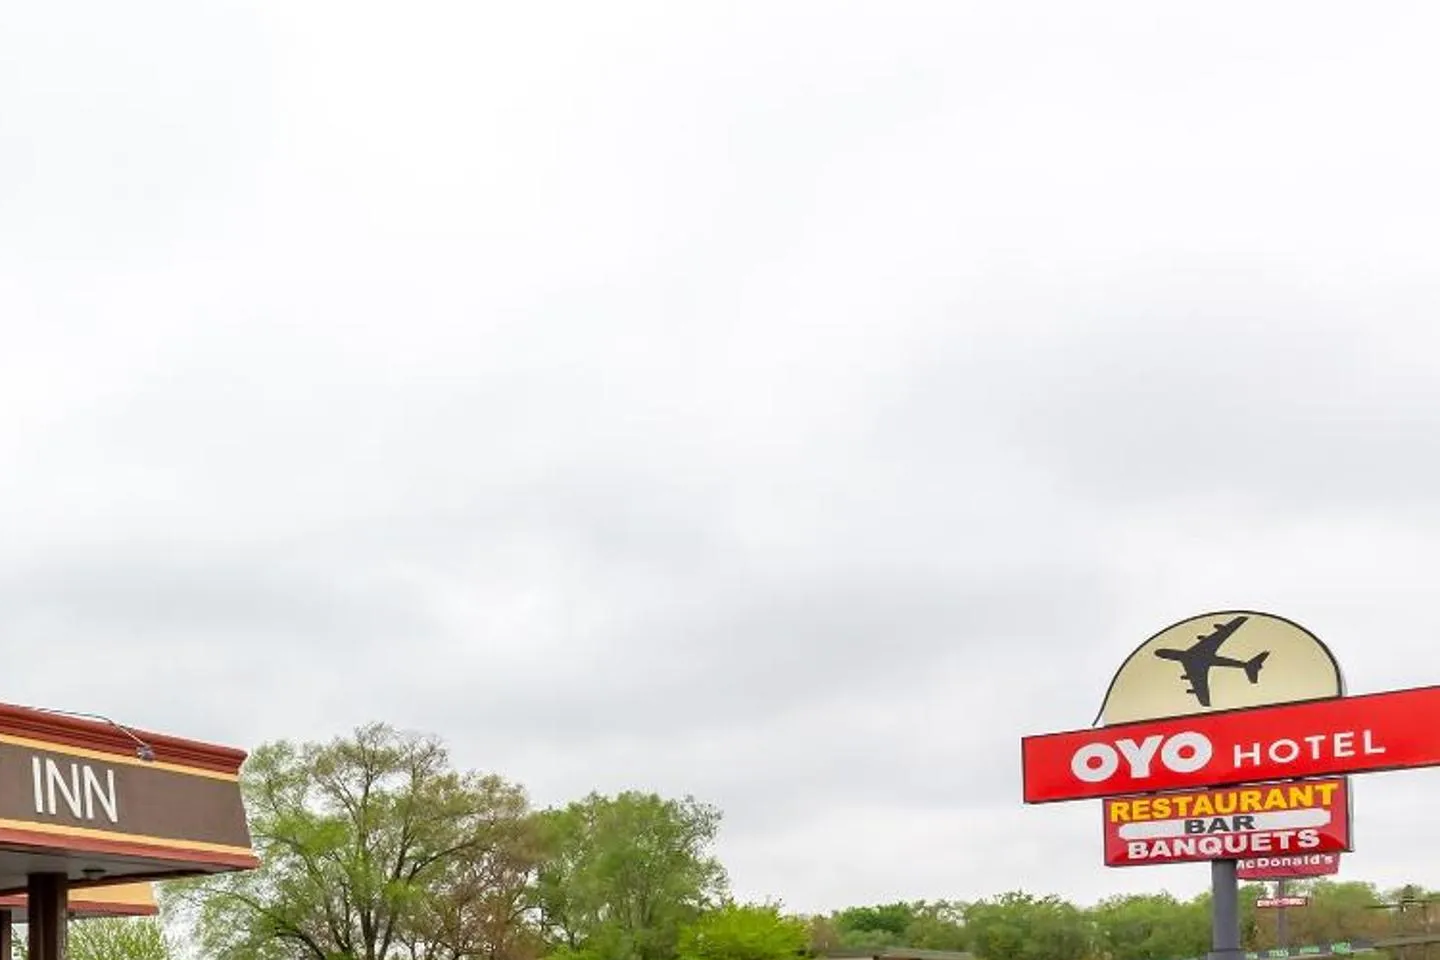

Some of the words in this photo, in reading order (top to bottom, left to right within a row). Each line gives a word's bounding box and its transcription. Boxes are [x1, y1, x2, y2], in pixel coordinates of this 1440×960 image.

[1071, 731, 1212, 782] OYO
[1234, 730, 1386, 768] HOTEL
[32, 756, 118, 823] INN
[1110, 783, 1339, 823] RESTAURANT
[1127, 829, 1321, 860] BANQUETS
[1184, 815, 1256, 834] BAR
